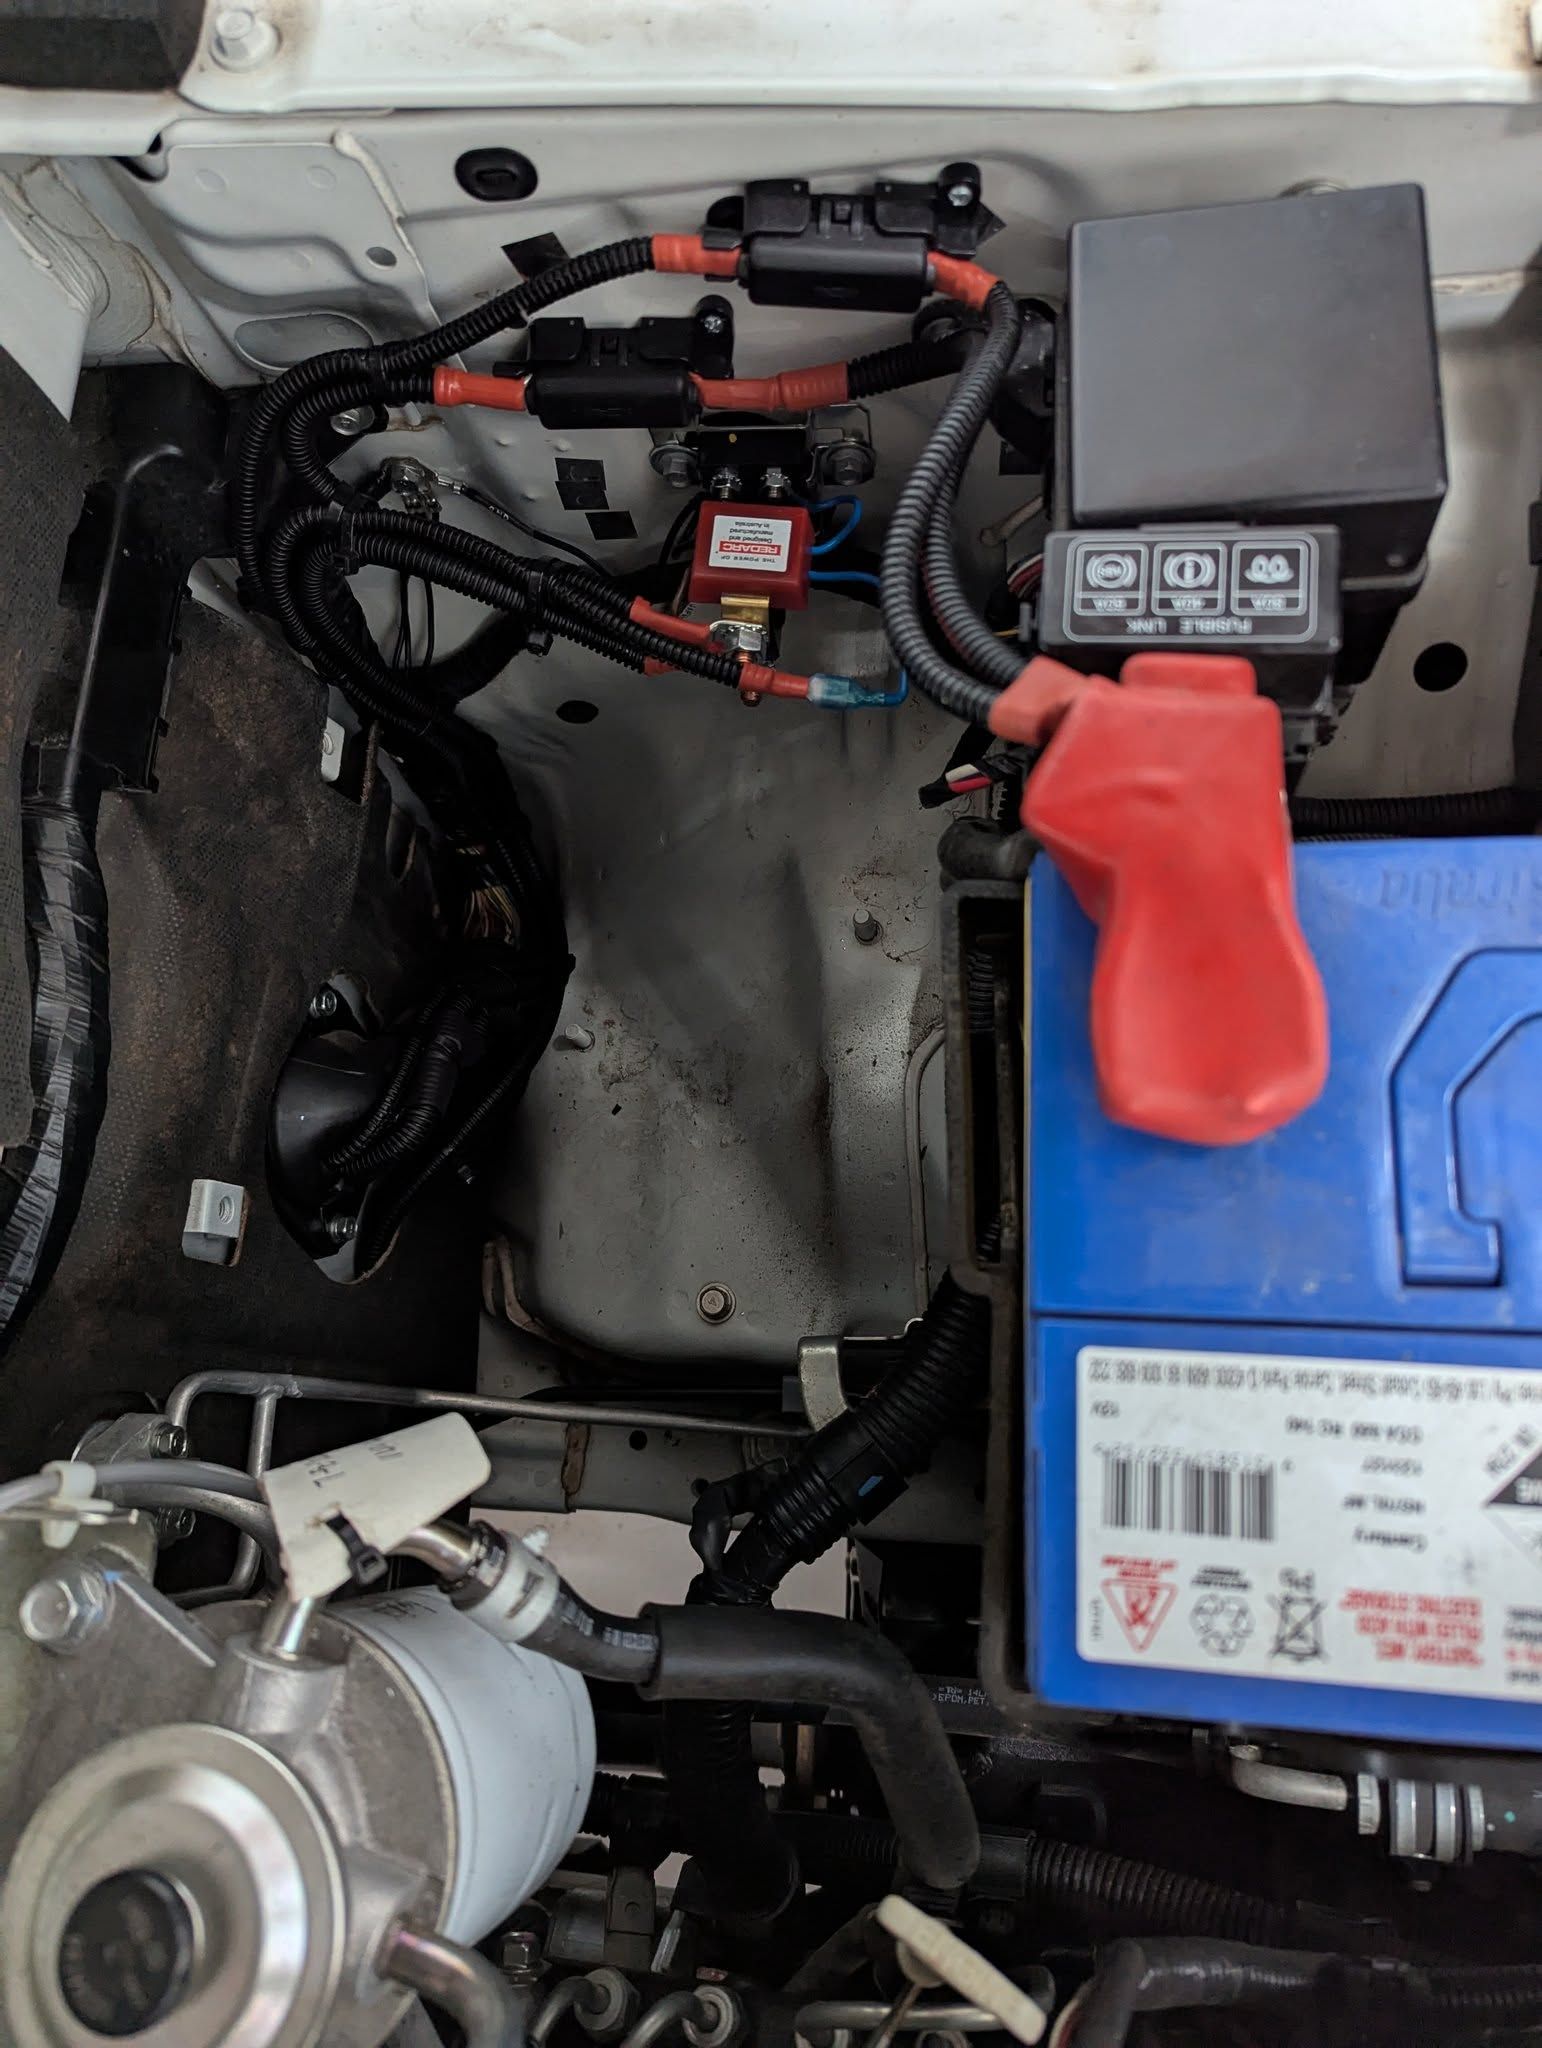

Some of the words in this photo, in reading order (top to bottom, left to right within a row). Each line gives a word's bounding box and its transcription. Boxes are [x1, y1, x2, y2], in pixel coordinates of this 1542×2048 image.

[729, 528, 773, 537] manufactured
[742, 536, 773, 544] Designed
[722, 543, 778, 554] REDARC
[1124, 617, 1167, 634] LINK
[1178, 616, 1253, 634] FUSIBLE
